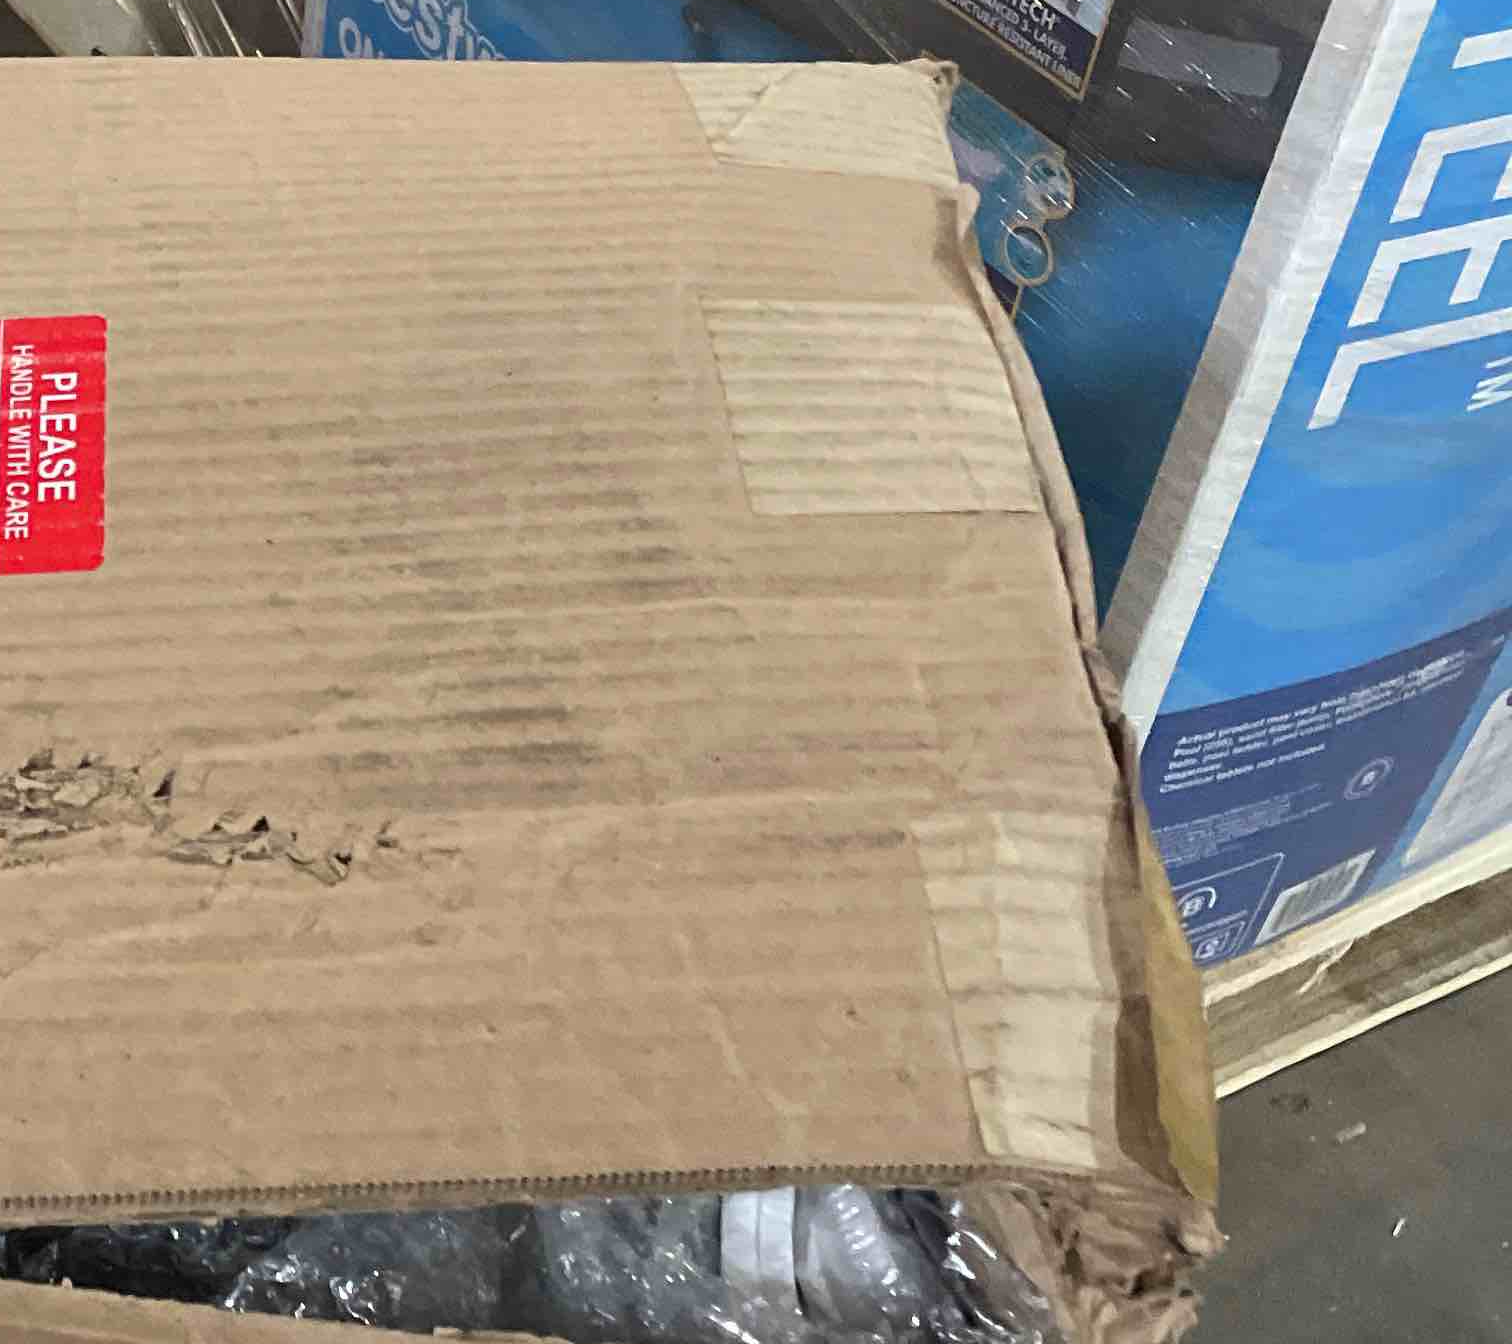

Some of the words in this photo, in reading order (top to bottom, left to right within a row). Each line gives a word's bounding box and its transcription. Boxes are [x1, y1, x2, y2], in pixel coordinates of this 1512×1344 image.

[7, 344, 35, 420] HANDLE
[6, 423, 34, 477] WITH
[37, 371, 79, 503] PLEASE
[4, 480, 32, 541] CARE
